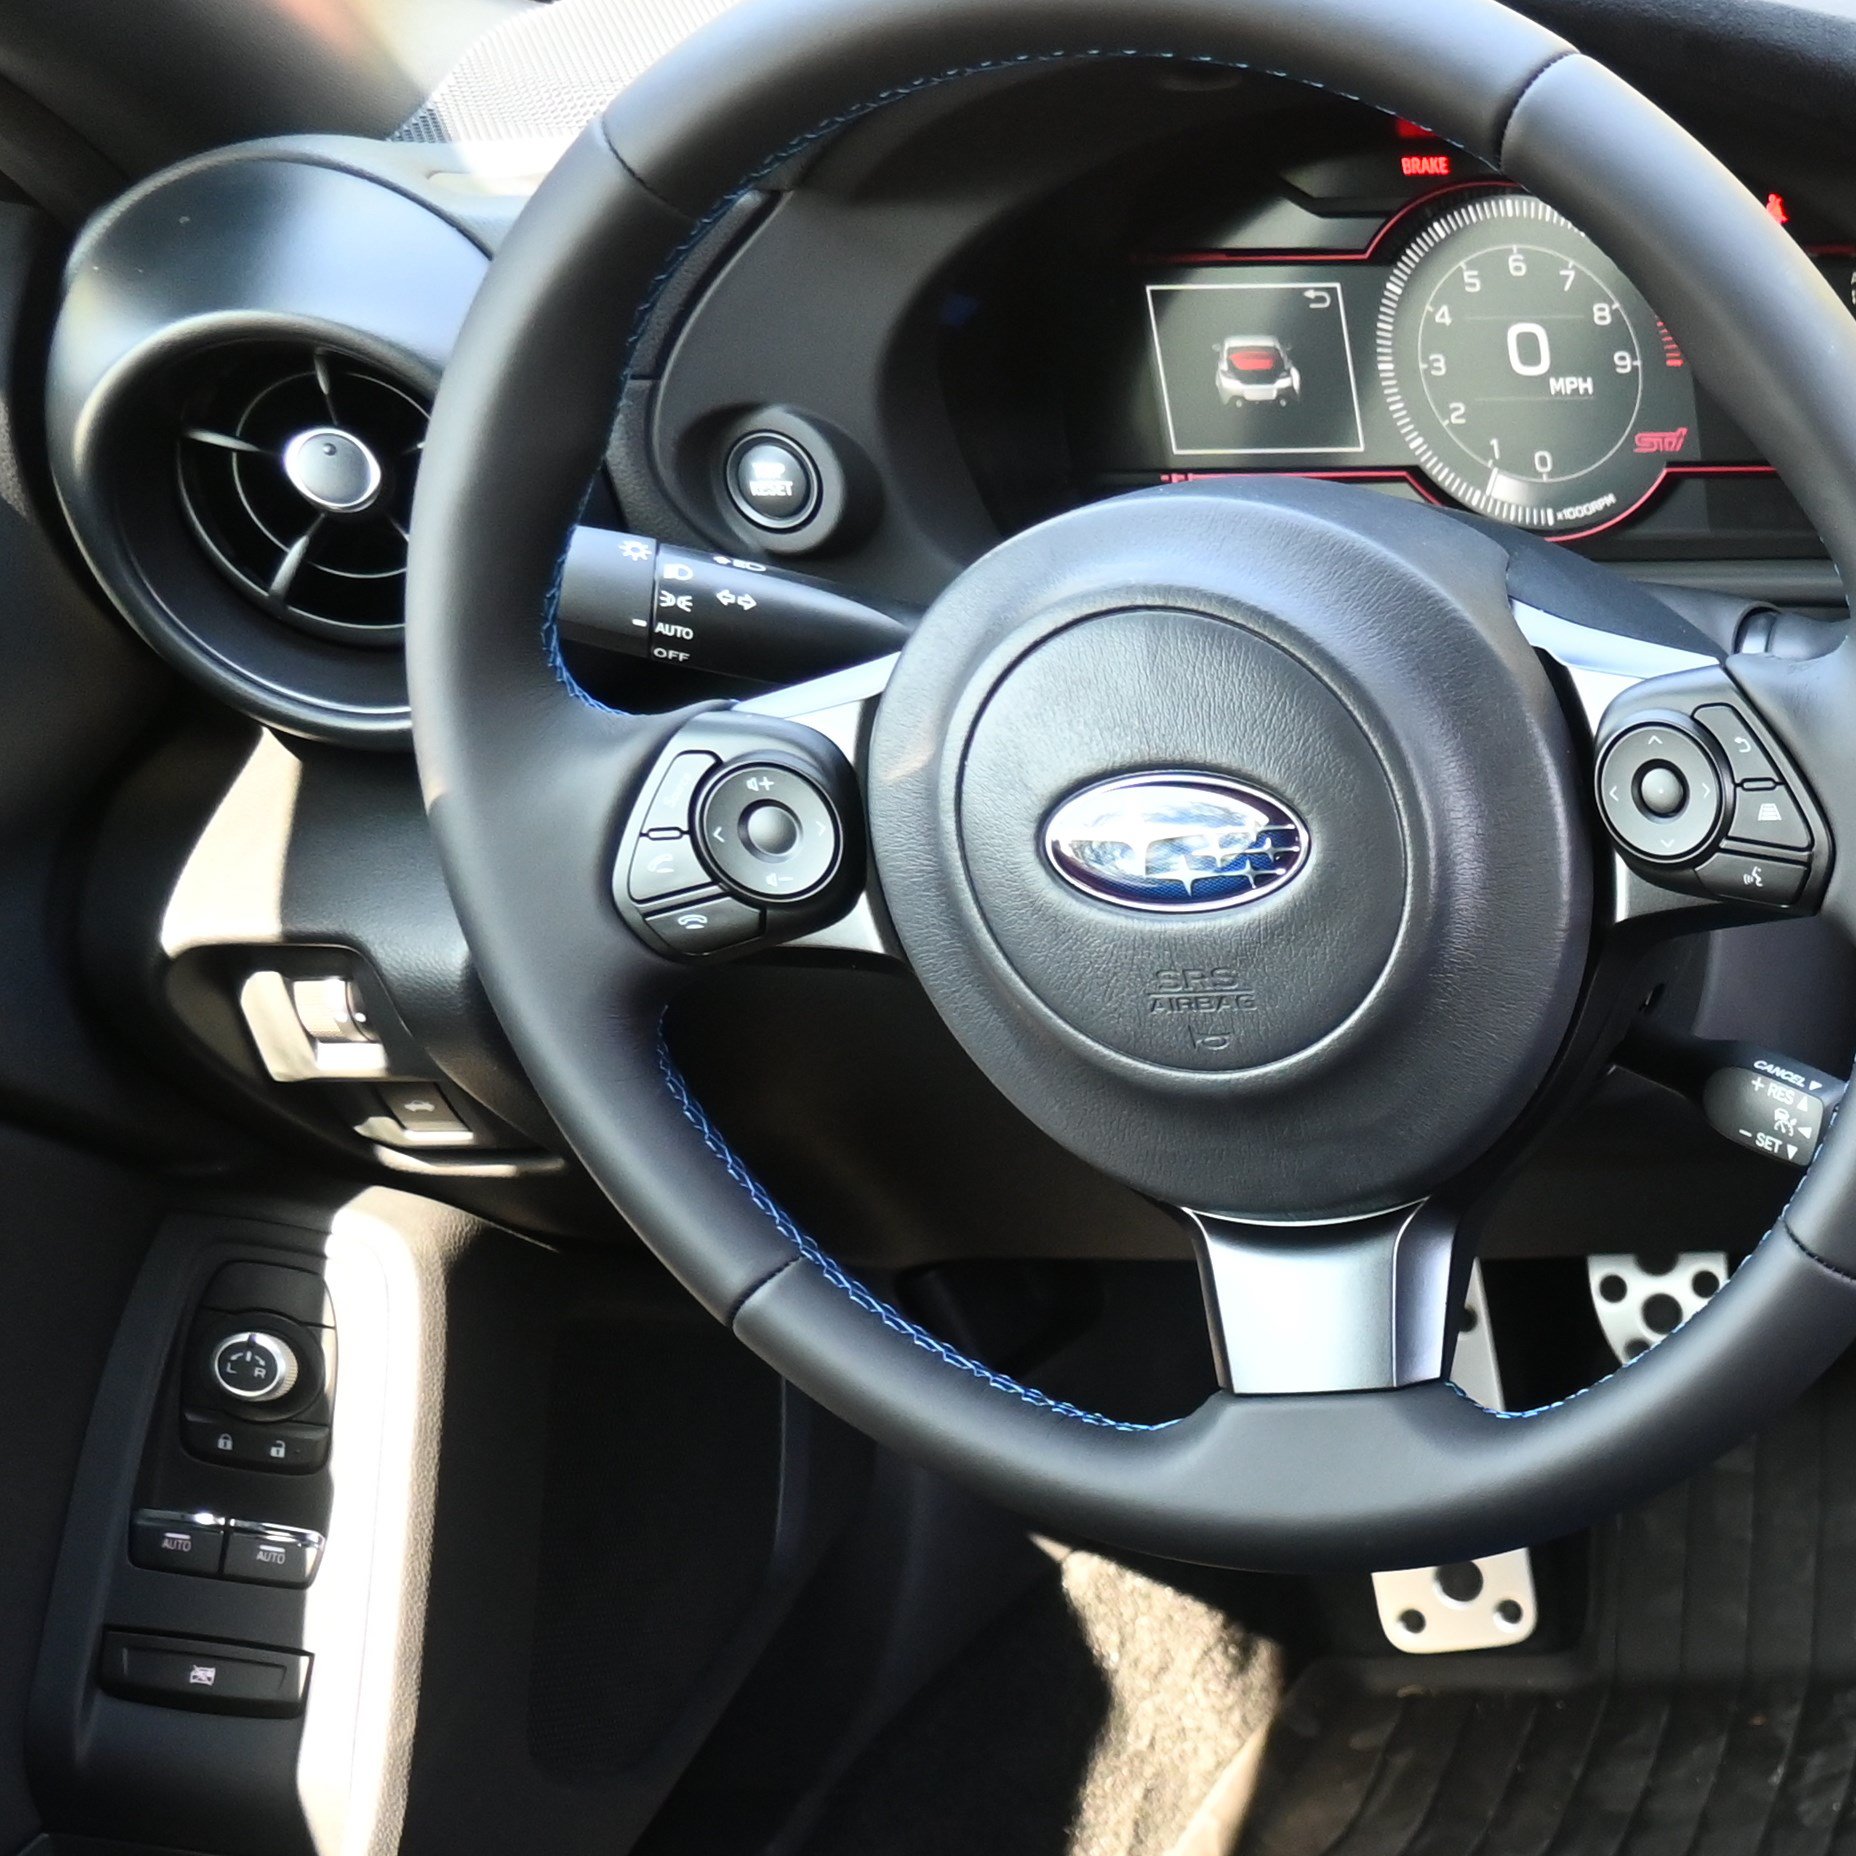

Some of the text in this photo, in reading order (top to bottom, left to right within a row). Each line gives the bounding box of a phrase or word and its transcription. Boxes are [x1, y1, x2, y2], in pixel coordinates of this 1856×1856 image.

[1401, 155, 1450, 176] BRAKE
[1508, 254, 1528, 277] 6
[1463, 270, 1482, 293] 5
[1559, 269, 1576, 292] 7
[1434, 304, 1453, 327] 4
[1592, 302, 1613, 326] 8
[1507, 321, 1551, 377] 0
[1428, 353, 1448, 377] 3
[1613, 350, 1633, 374] 9
[1549, 376, 1594, 396] MPH
[1448, 402, 1467, 425] 2
[1489, 437, 1501, 460] 1
[1533, 450, 1554, 473] 0
[654, 621, 695, 642] AUTO
[652, 647, 691, 663] OFF
[1155, 967, 1239, 992] SRS
[1149, 993, 1258, 1015] AIRBAG
[1753, 1060, 1807, 1088] CANCEL
[1767, 1082, 1796, 1106] RES
[1755, 1132, 1783, 1154] SET
[252, 1366, 267, 1380] R
[161, 1538, 193, 1554] AUTO
[256, 1550, 286, 1566] AUTO
